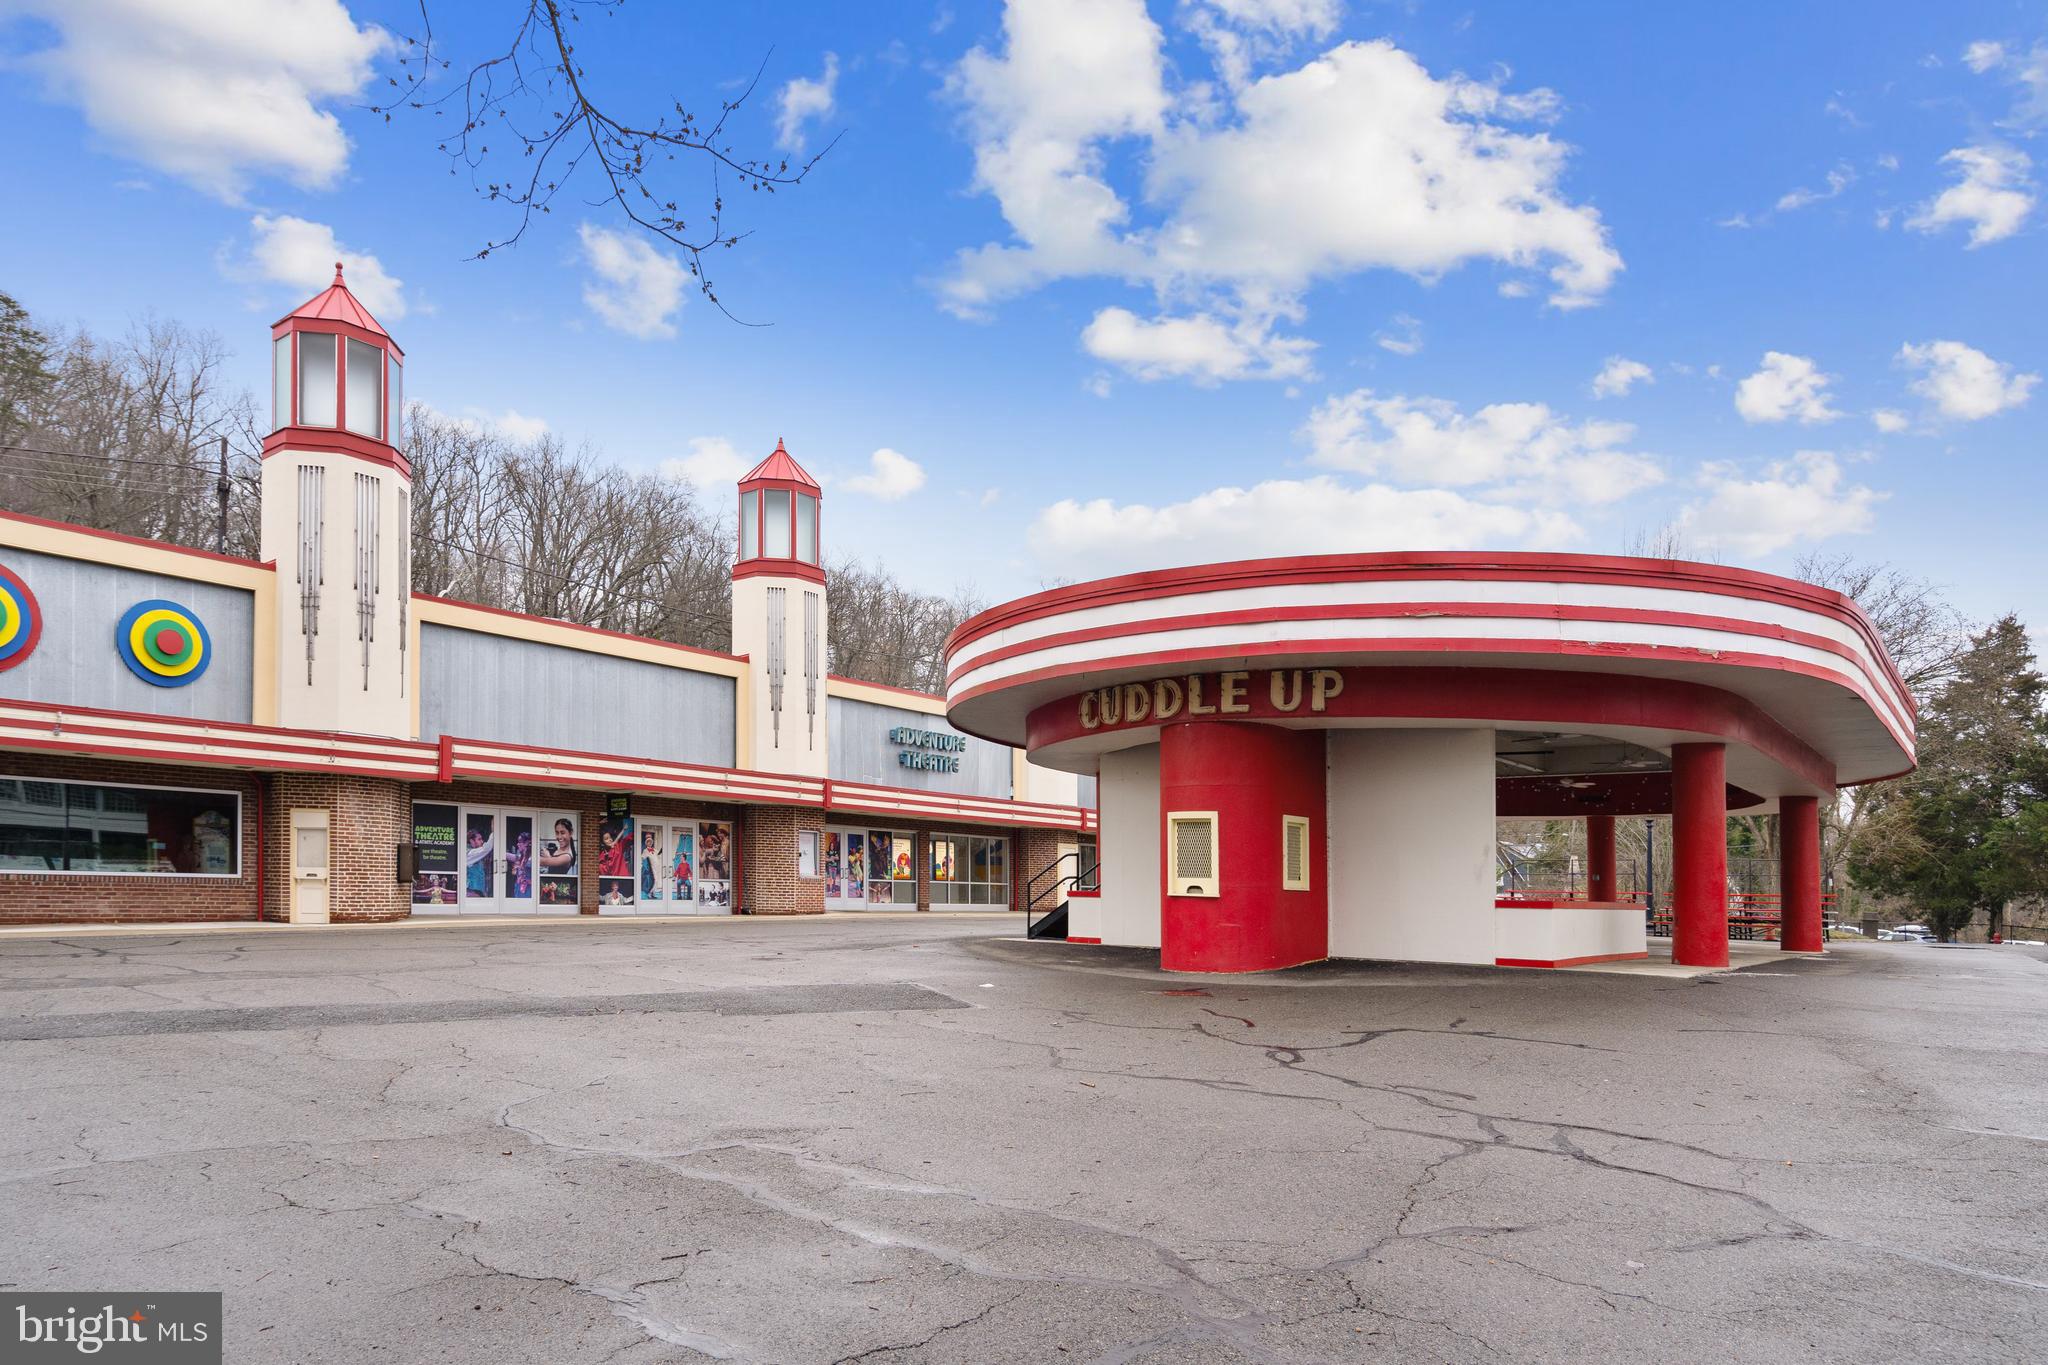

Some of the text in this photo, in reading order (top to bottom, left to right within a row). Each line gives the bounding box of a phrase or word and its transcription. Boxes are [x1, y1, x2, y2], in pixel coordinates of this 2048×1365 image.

[1078, 669, 1344, 729] CUDDLE UP
[893, 727, 966, 752] ADVENTURE
[902, 750, 959, 773] THEATRE
[415, 825, 454, 834] ADVENTURE
[415, 831, 455, 841] THEATRE
